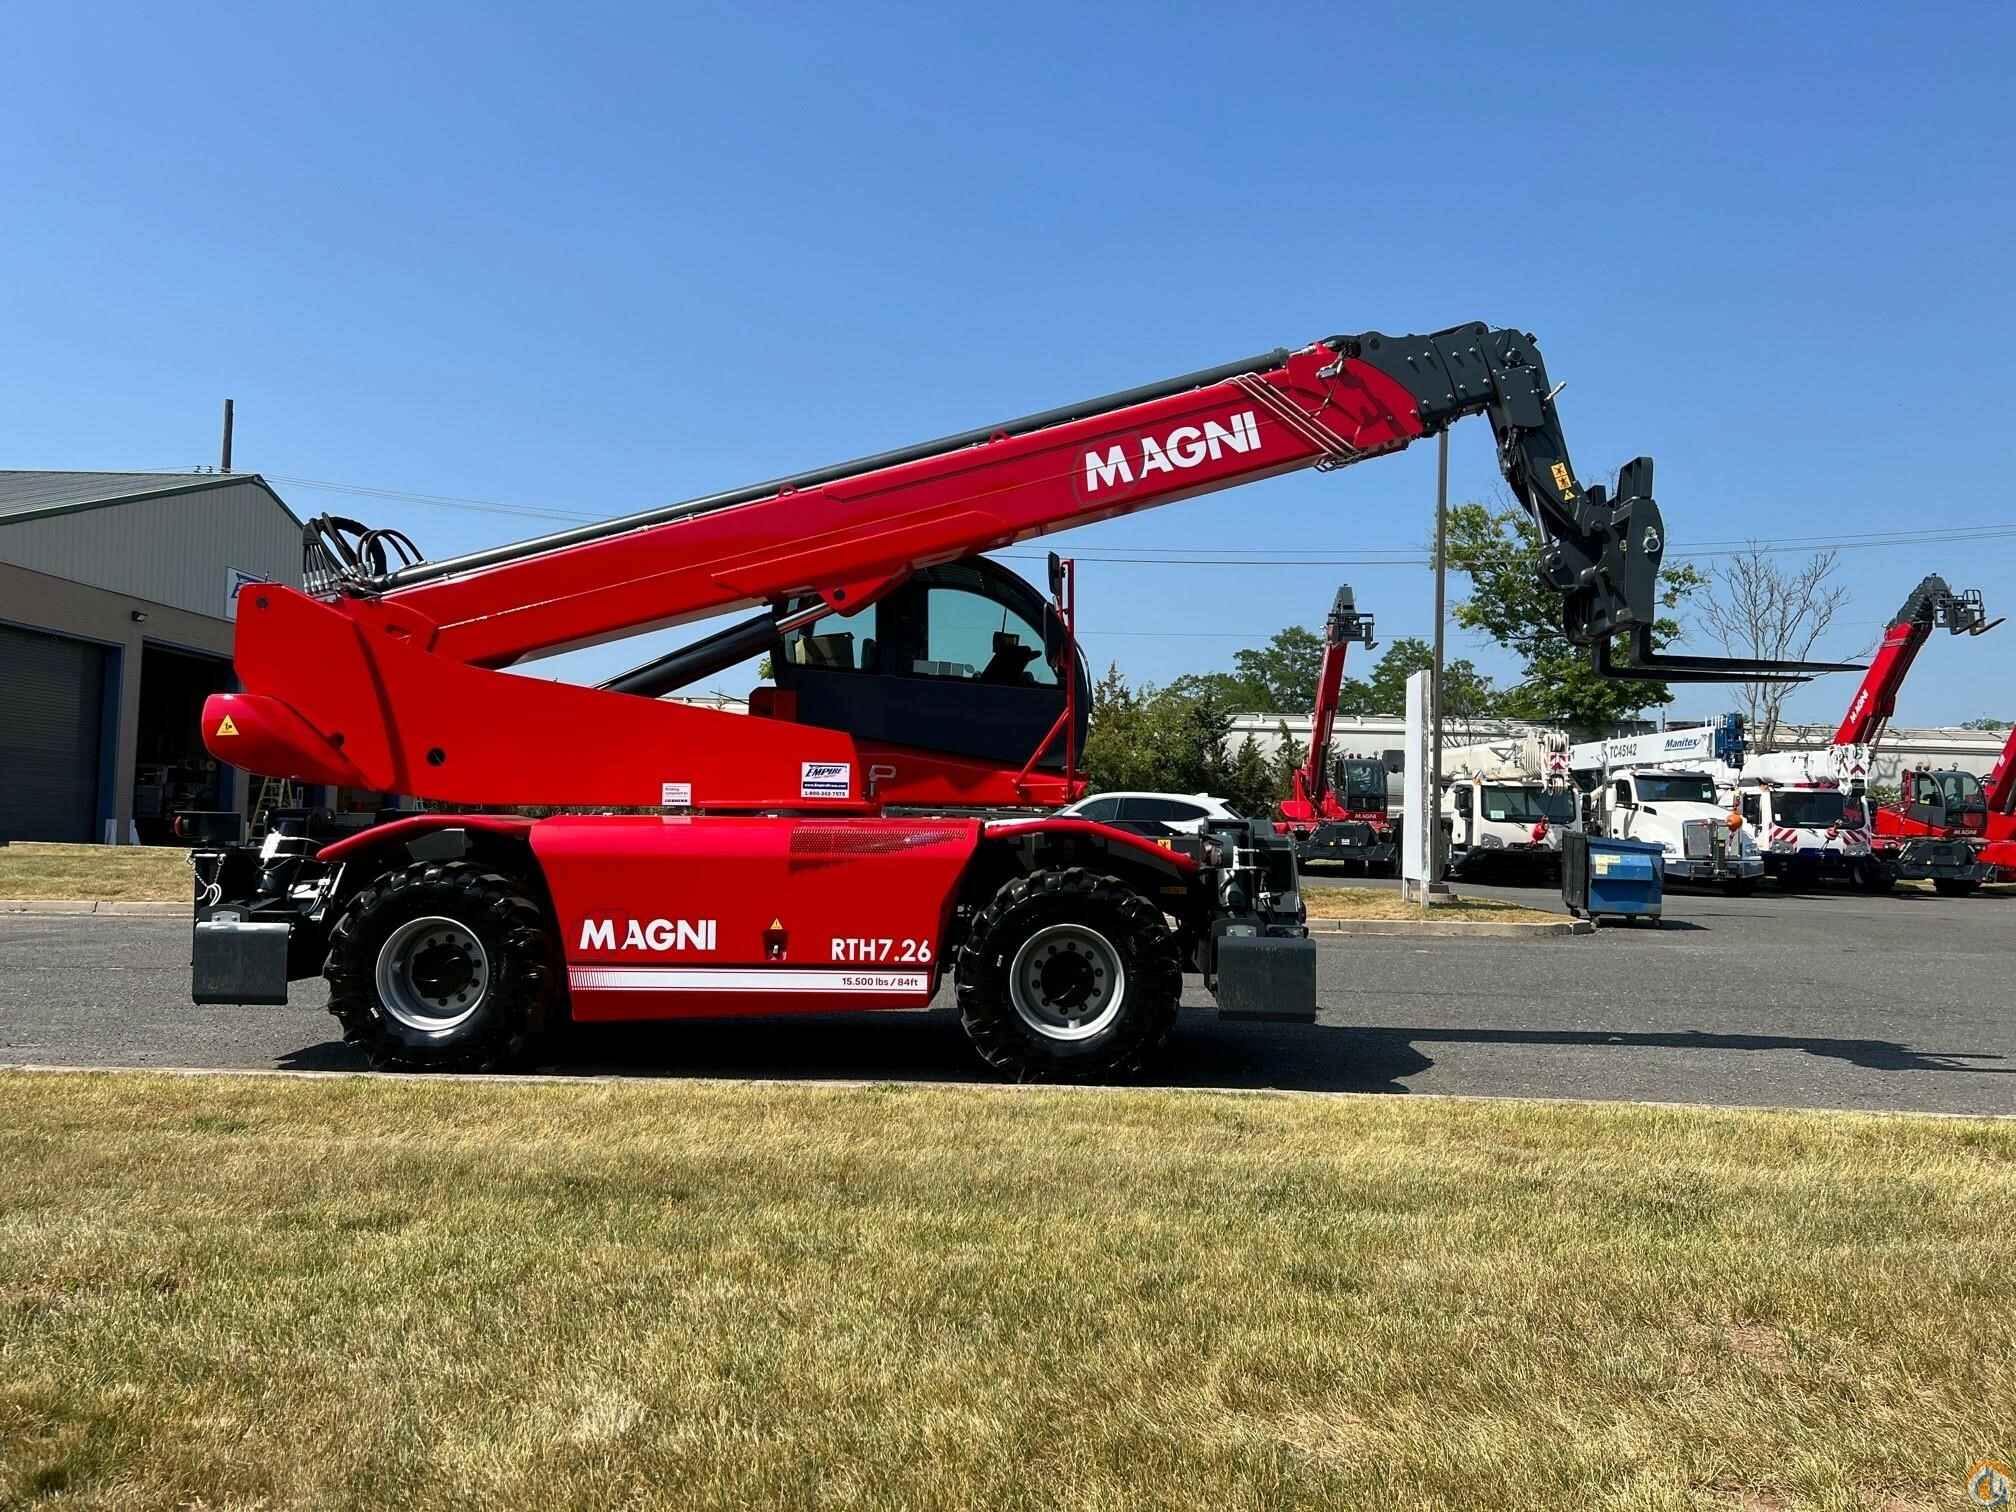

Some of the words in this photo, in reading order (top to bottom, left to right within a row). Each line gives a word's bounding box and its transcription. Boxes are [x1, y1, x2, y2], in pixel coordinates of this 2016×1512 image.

[1664, 737, 1699, 750] Manitex
[1610, 743, 1638, 759] TC45142
[831, 938, 931, 962] RTH7.26
[842, 977, 873, 986] 15.500
[876, 977, 888, 986] lbs
[890, 977, 896, 986] /
[898, 977, 919, 987] 84ft
